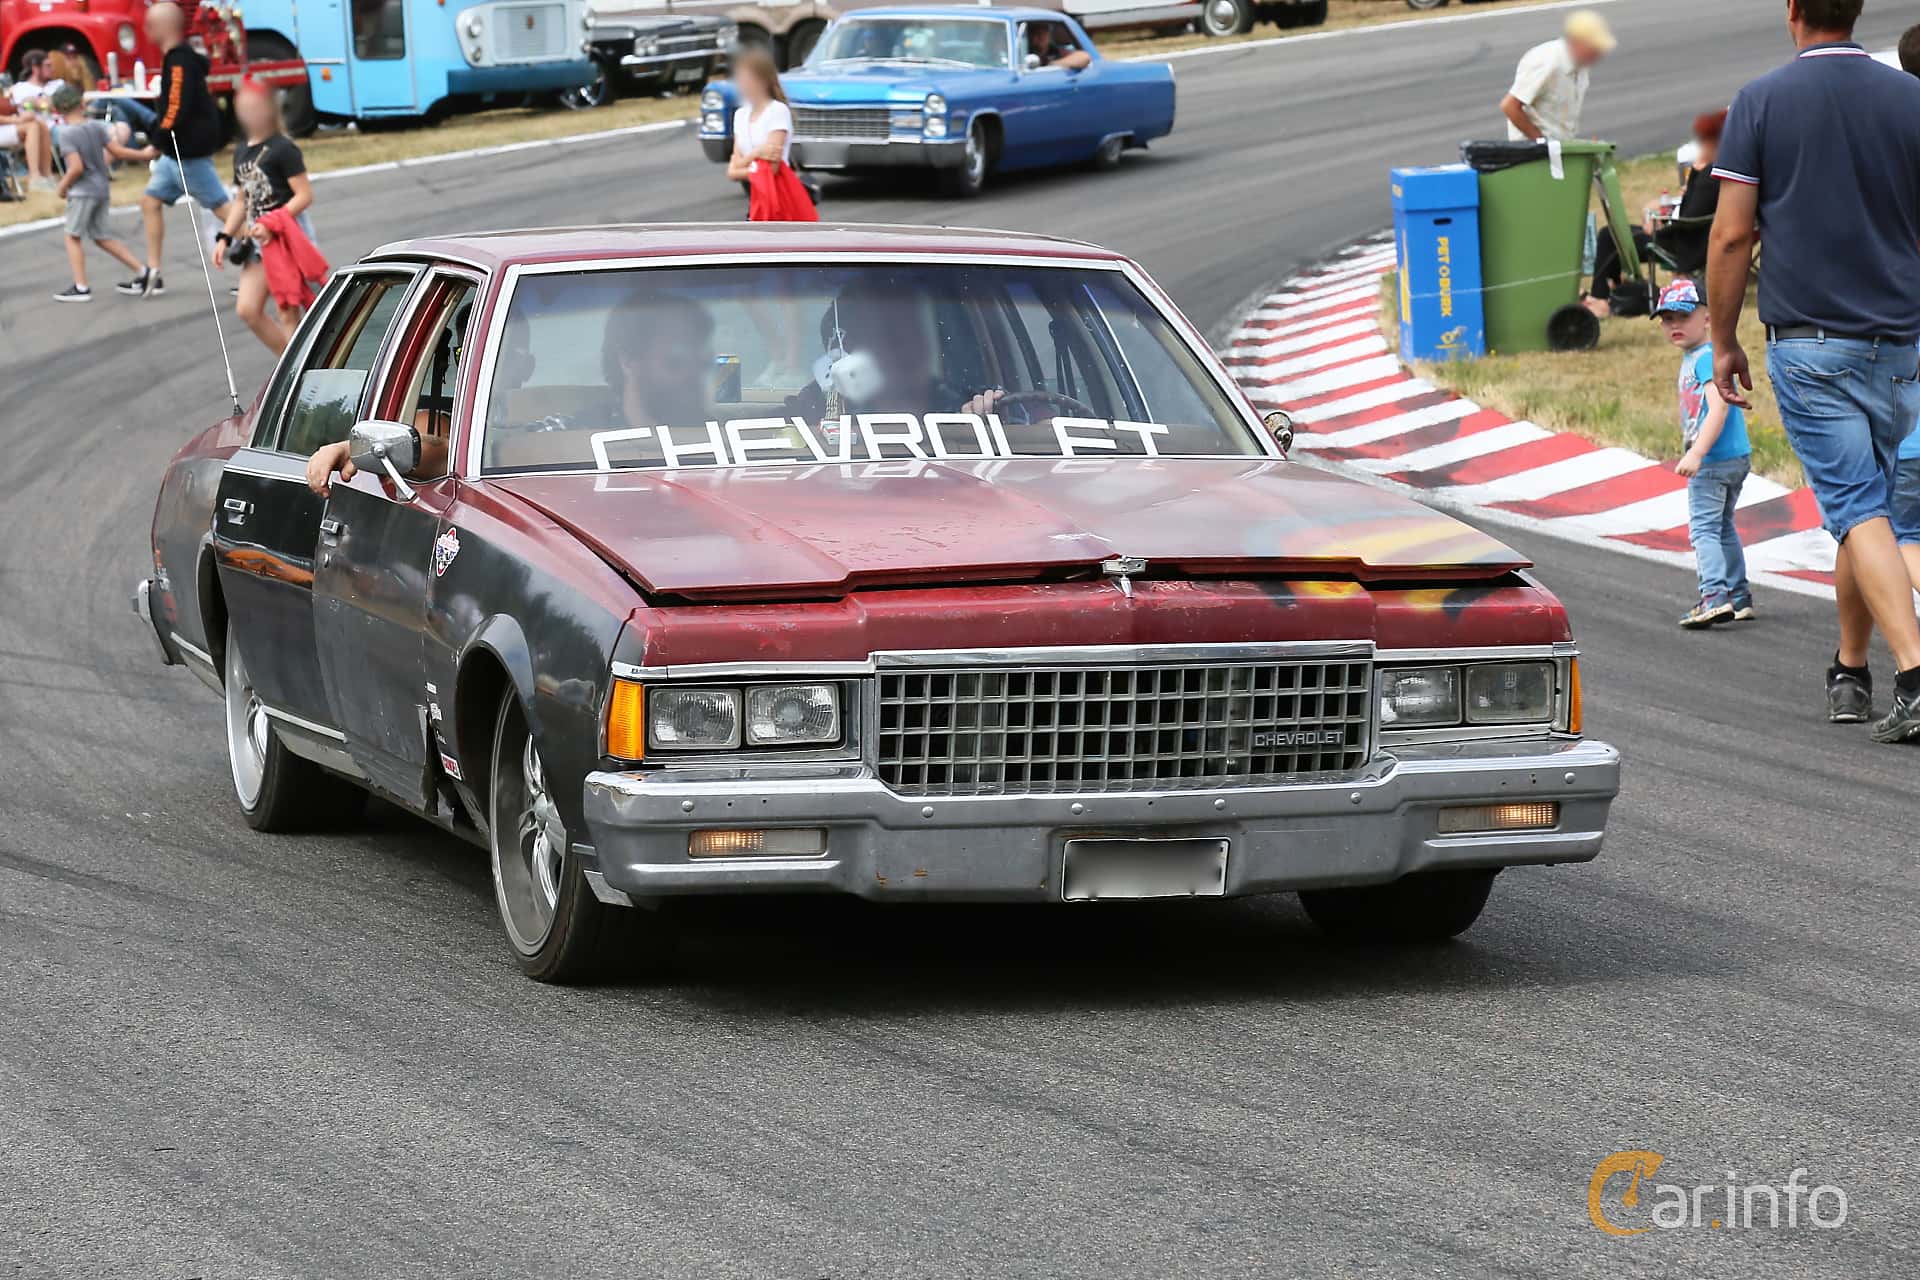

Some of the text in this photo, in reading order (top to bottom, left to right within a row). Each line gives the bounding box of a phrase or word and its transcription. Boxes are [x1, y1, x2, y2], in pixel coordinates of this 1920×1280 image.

[1437, 236, 1450, 264] PET
[590, 412, 1170, 470] CHEVROLET
[1255, 731, 1344, 746] CHEVROLET
